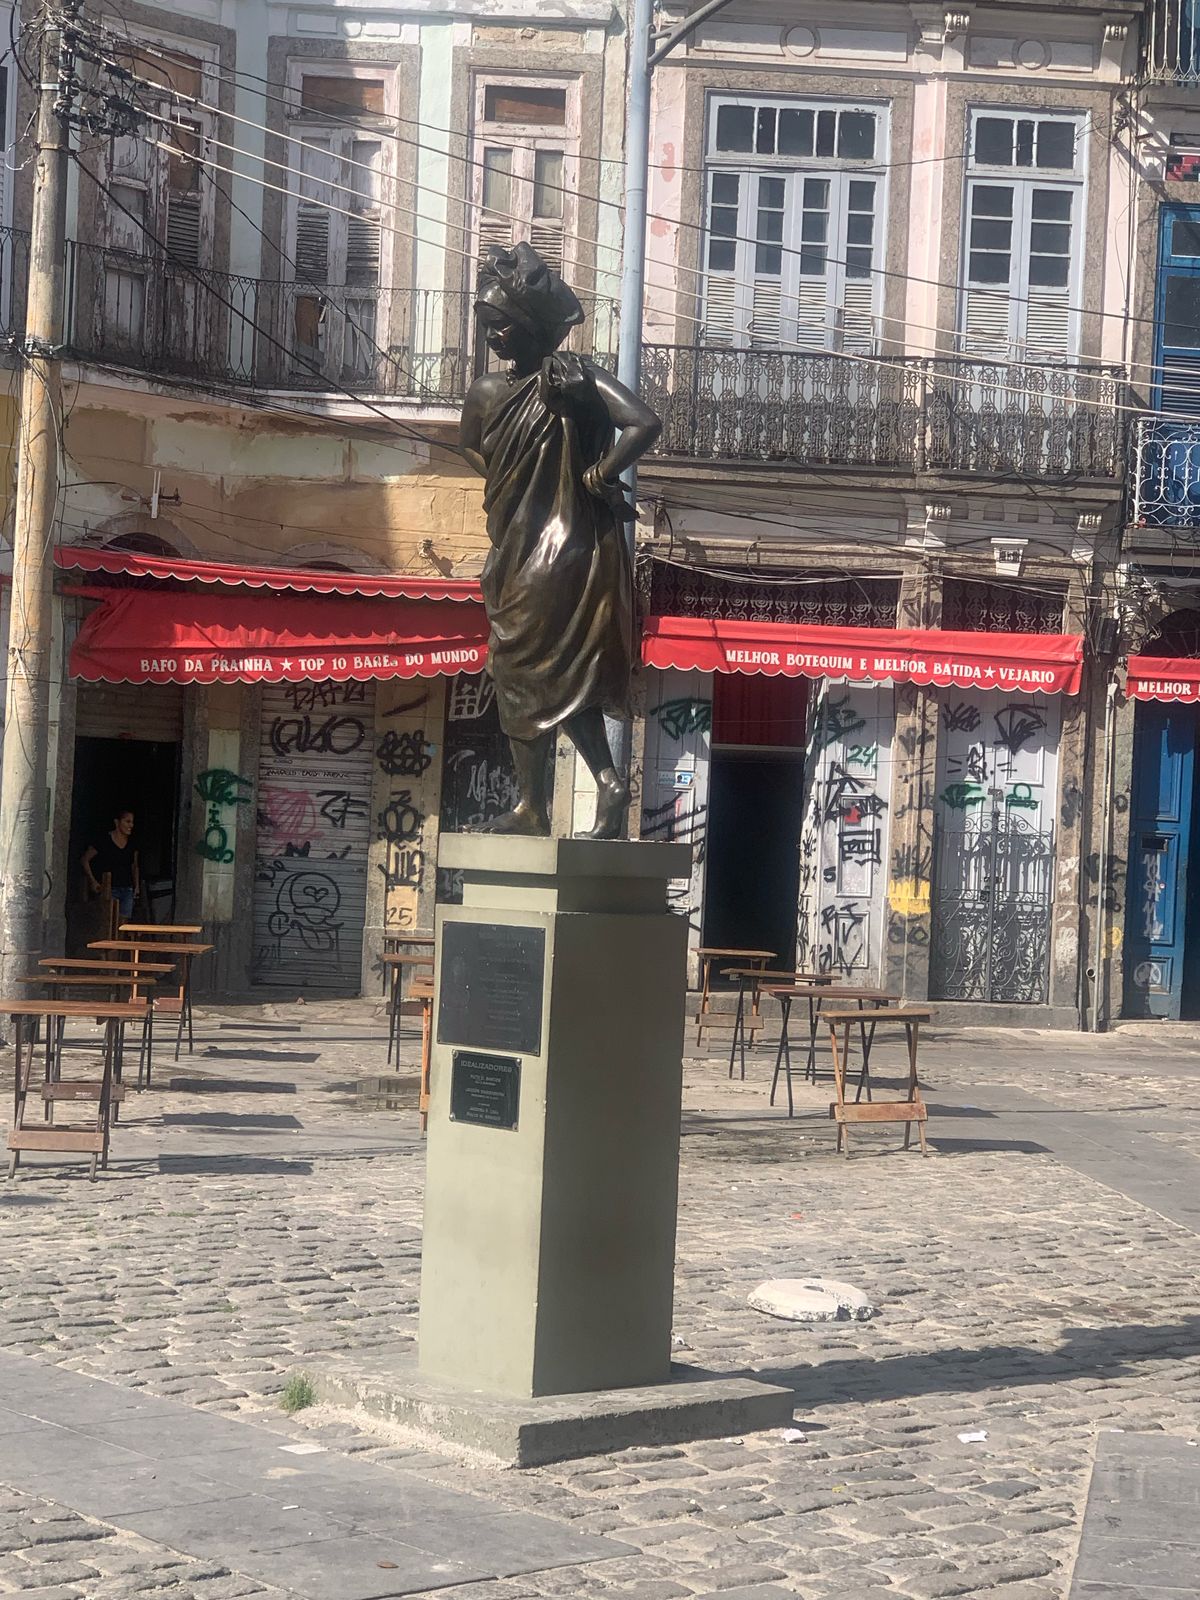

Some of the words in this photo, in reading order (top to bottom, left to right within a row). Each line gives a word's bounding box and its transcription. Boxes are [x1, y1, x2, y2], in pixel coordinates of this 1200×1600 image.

[140, 659, 178, 673] BAFO
[184, 659, 204, 673] DA
[211, 658, 273, 673] PRAINHA
[298, 657, 325, 672] TOP
[332, 657, 347, 670] 10
[405, 652, 424, 666] DO
[431, 648, 479, 665] MUNDO
[726, 650, 780, 665] MELHOR
[786, 653, 852, 669] BOTEQUIM
[859, 658, 867, 671] E
[873, 658, 927, 674] MELHOR
[933, 662, 982, 679] BATIDA
[999, 667, 1055, 684] VEJARIO
[1137, 681, 1191, 696] MELHOR
[386, 907, 413, 926] 25
